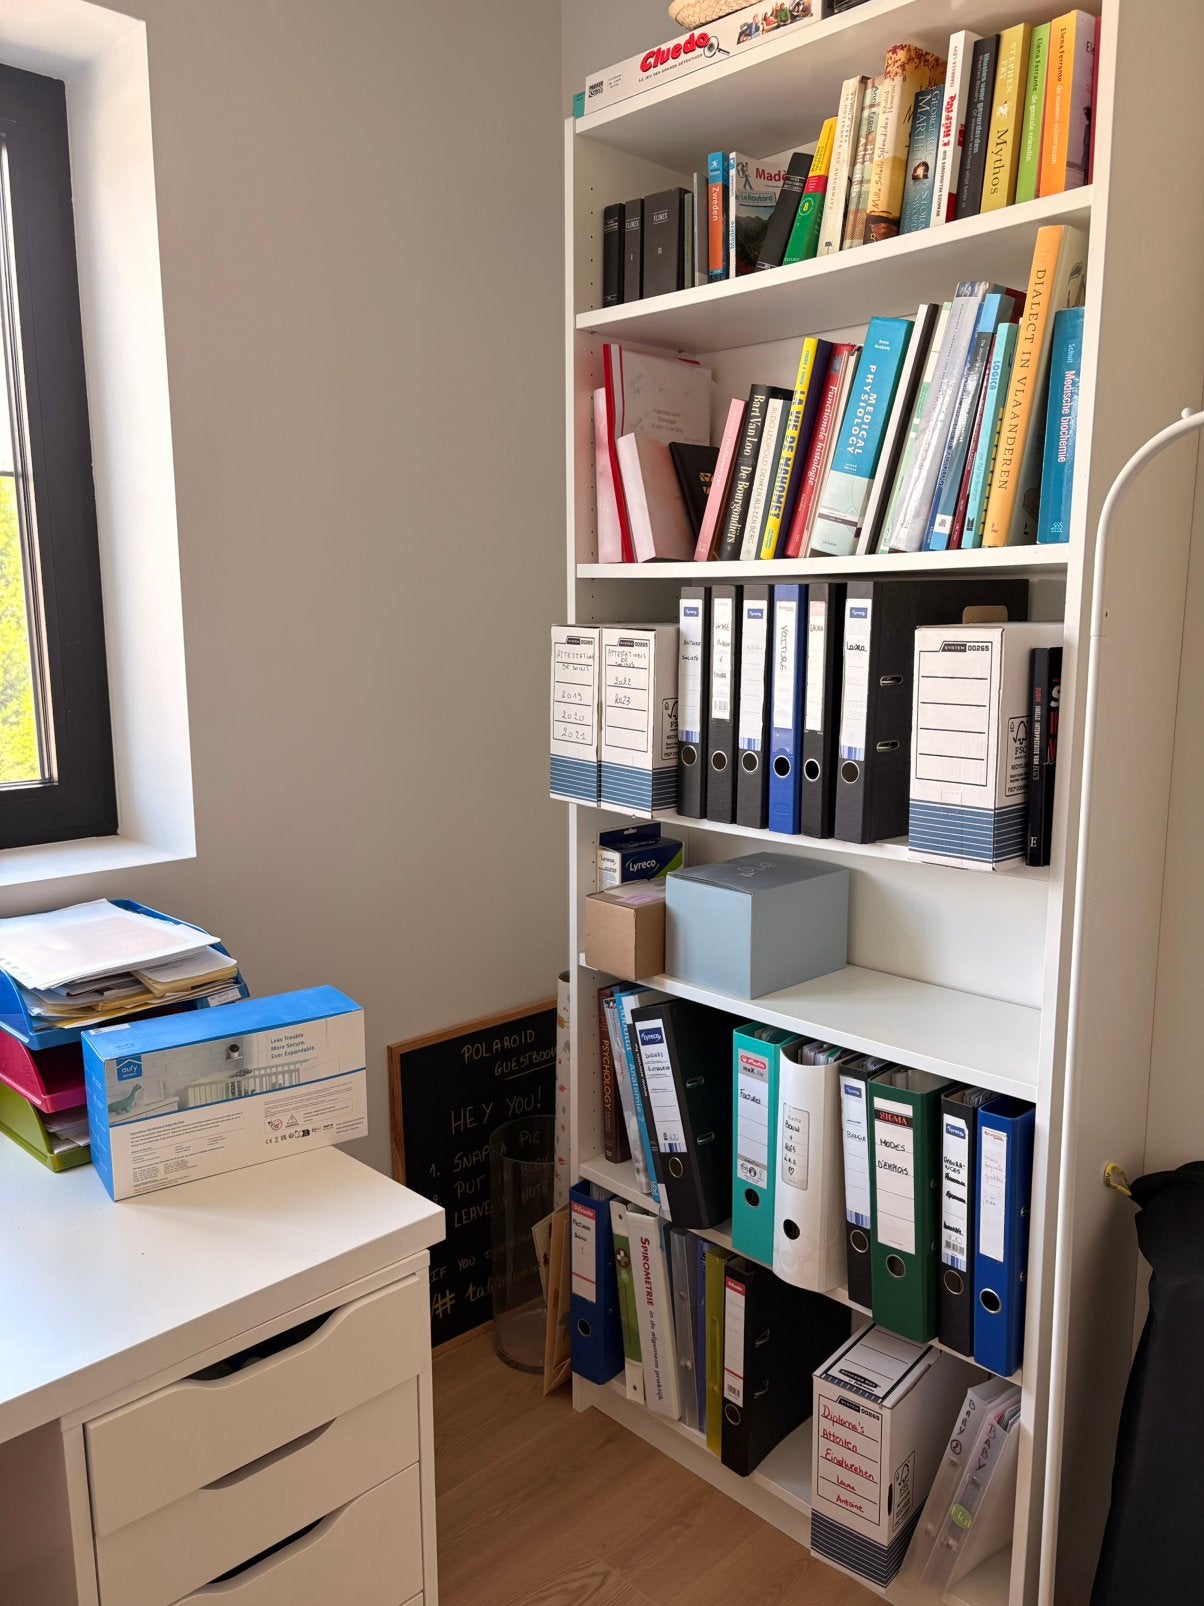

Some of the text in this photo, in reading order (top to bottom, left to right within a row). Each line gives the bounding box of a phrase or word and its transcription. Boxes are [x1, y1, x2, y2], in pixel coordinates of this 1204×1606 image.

[639, 32, 710, 73] Cluedo
[1058, 27, 1067, 47] Elena
[1000, 59, 1009, 80] FRY
[1005, 41, 1017, 94] STEPHEN
[1056, 47, 1065, 82] Ferrante
[867, 86, 879, 137] Anne Frank
[1024, 38, 1043, 161] Elena Ferrante de geniale vriendin
[972, 104, 985, 154] gevorderden
[872, 186, 882, 209] Mille
[877, 117, 890, 160] Splendides
[989, 128, 1009, 195] Mythos
[711, 186, 720, 222] Zweden
[803, 202, 809, 212] 8
[989, 360, 1001, 390] LOGICA
[997, 268, 1046, 491] DIALECT IN VLAANDEREN
[846, 364, 877, 456] PHYSIOLOGY
[1060, 370, 1076, 416] Medische
[788, 411, 802, 432] VIE
[807, 385, 838, 486] Functionele histologie
[854, 393, 877, 455] MEDICAL
[783, 435, 797, 453] DE
[1057, 417, 1074, 463] biochemie
[727, 395, 765, 543] Bart Van Loo De Bourgondiërs
[769, 457, 793, 520] MAHOMET
[561, 692, 583, 701] 2019
[614, 676, 632, 686] 2022
[561, 710, 584, 721] 2020
[614, 693, 631, 705] 2023
[561, 727, 587, 740] 2021
[629, 859, 656, 872] Lyreco
[270, 1040, 305, 1051] More Secure.
[271, 1045, 315, 1059] Ever Expandable.
[461, 1030, 535, 1064] POLAROID
[641, 1032, 662, 1042] Lyreco
[602, 1039, 612, 1111] PSYCHOLOGY
[629, 1063, 641, 1113] Anatomie
[451, 1085, 542, 1135] HEY YOU!
[880, 1111, 907, 1126] SIGMA
[453, 1145, 490, 1172] SNAP
[518, 1130, 541, 1147] PIC
[880, 1139, 906, 1152] MODES
[878, 1160, 909, 1175] D'EMPLOIS
[454, 1174, 486, 1199] PUT
[454, 1200, 493, 1228] LEAVE
[457, 1256, 476, 1271] YOU
[640, 1237, 654, 1307] SPIROMETRIE
[957, 1399, 977, 1435] BABY
[976, 1422, 996, 1471] BABY
[836, 1494, 865, 1513] Antoine
